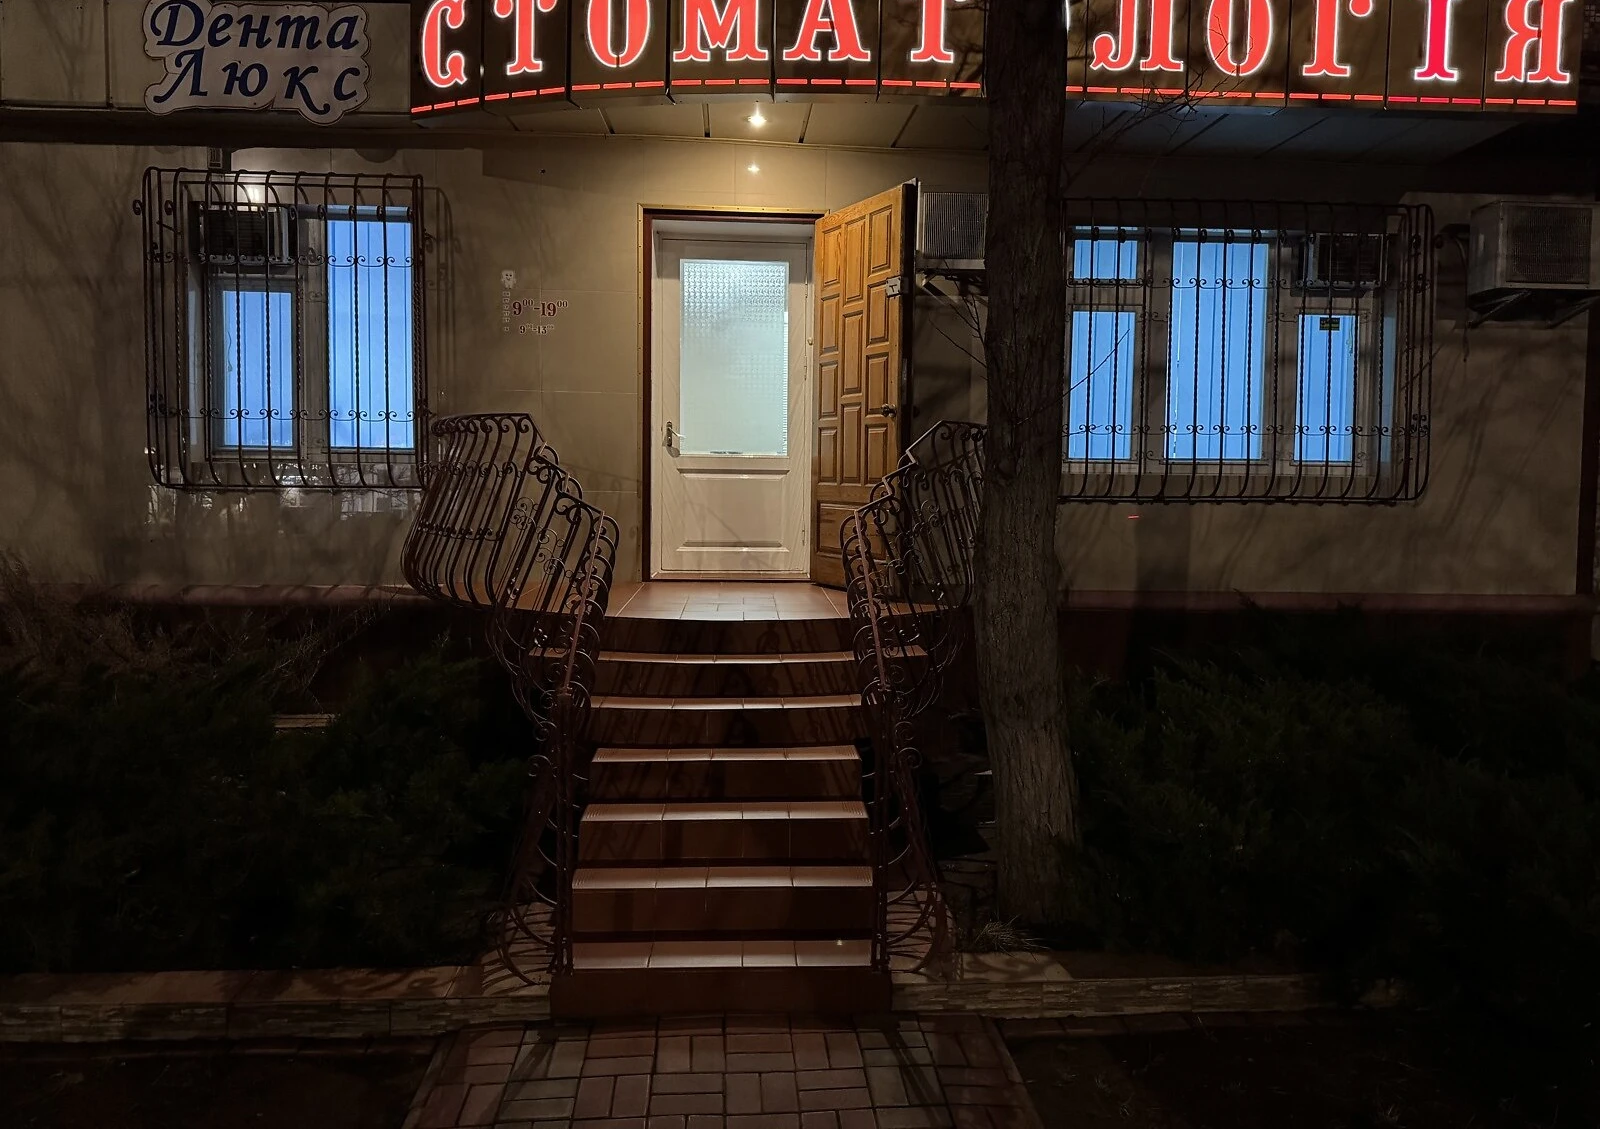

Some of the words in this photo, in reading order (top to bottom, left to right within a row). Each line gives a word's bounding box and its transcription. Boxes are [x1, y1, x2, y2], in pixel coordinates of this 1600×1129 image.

[150, 1, 360, 49] Дента
[422, 0, 1571, 88] СТОМАТЛОГІЯ
[153, 46, 361, 115] Люкс
